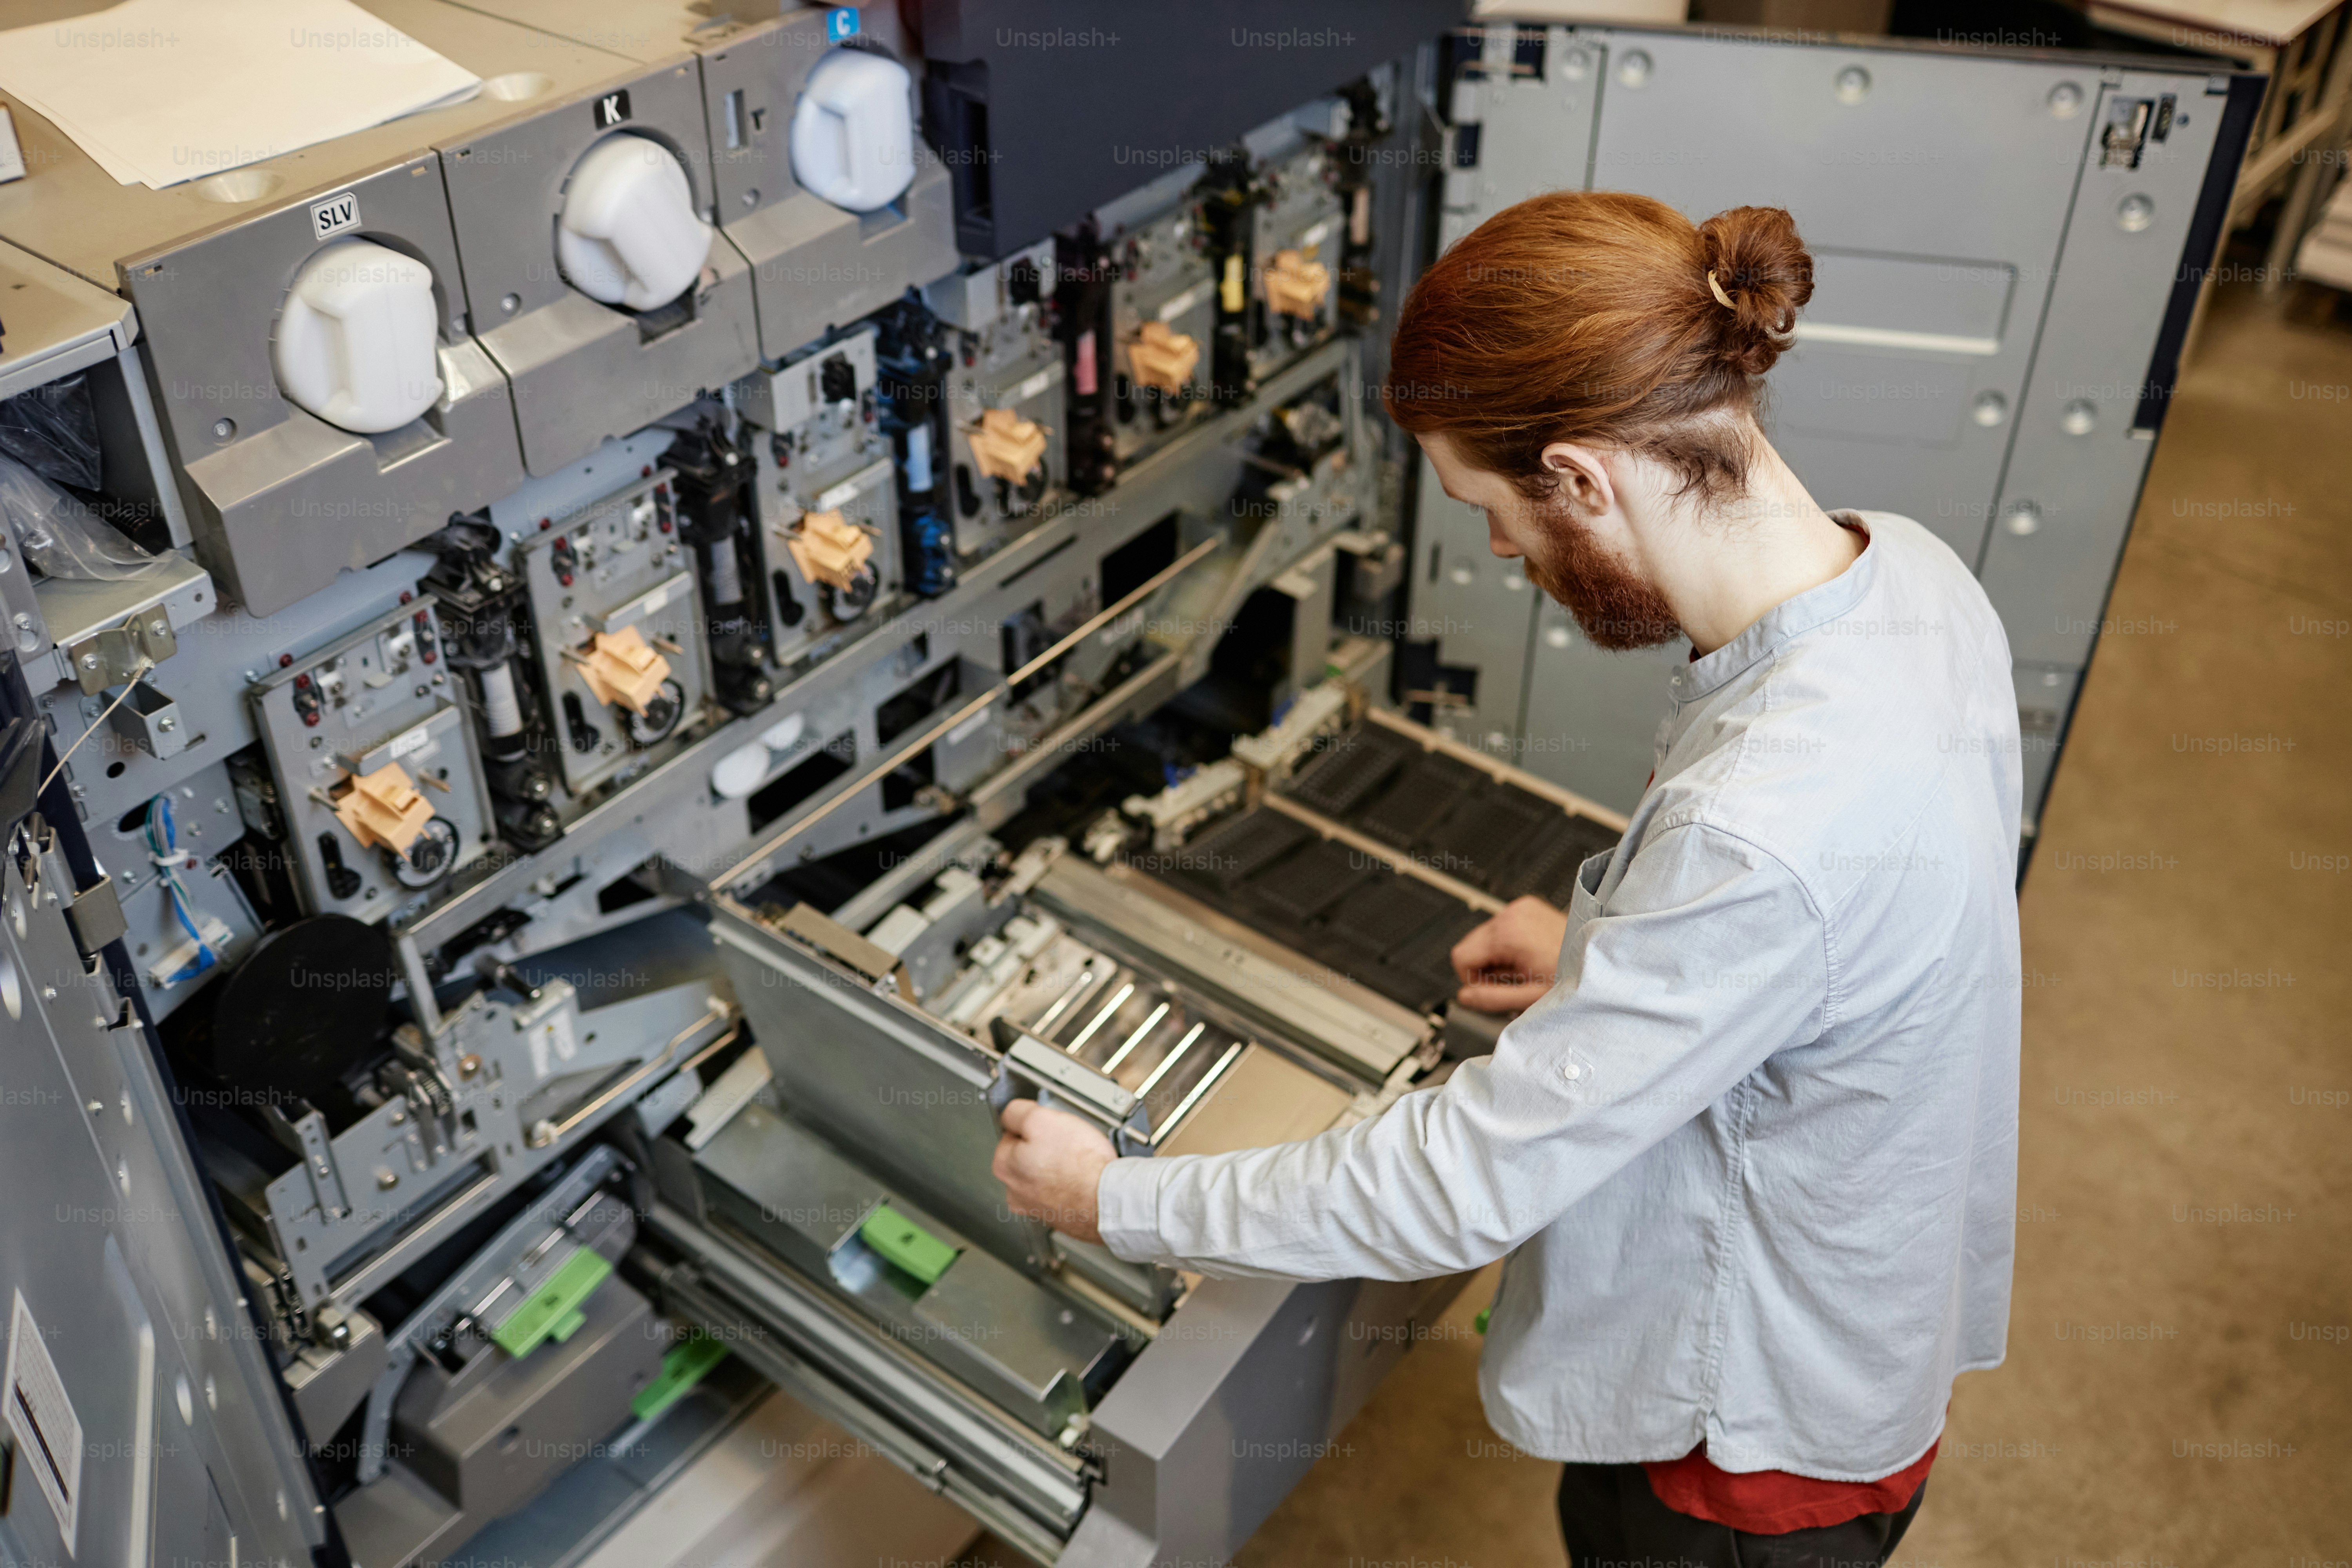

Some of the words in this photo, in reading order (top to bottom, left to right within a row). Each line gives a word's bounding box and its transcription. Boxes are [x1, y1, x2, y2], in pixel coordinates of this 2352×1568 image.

[836, 10, 851, 35] C
[603, 95, 622, 125] K
[319, 201, 351, 230] SLV
